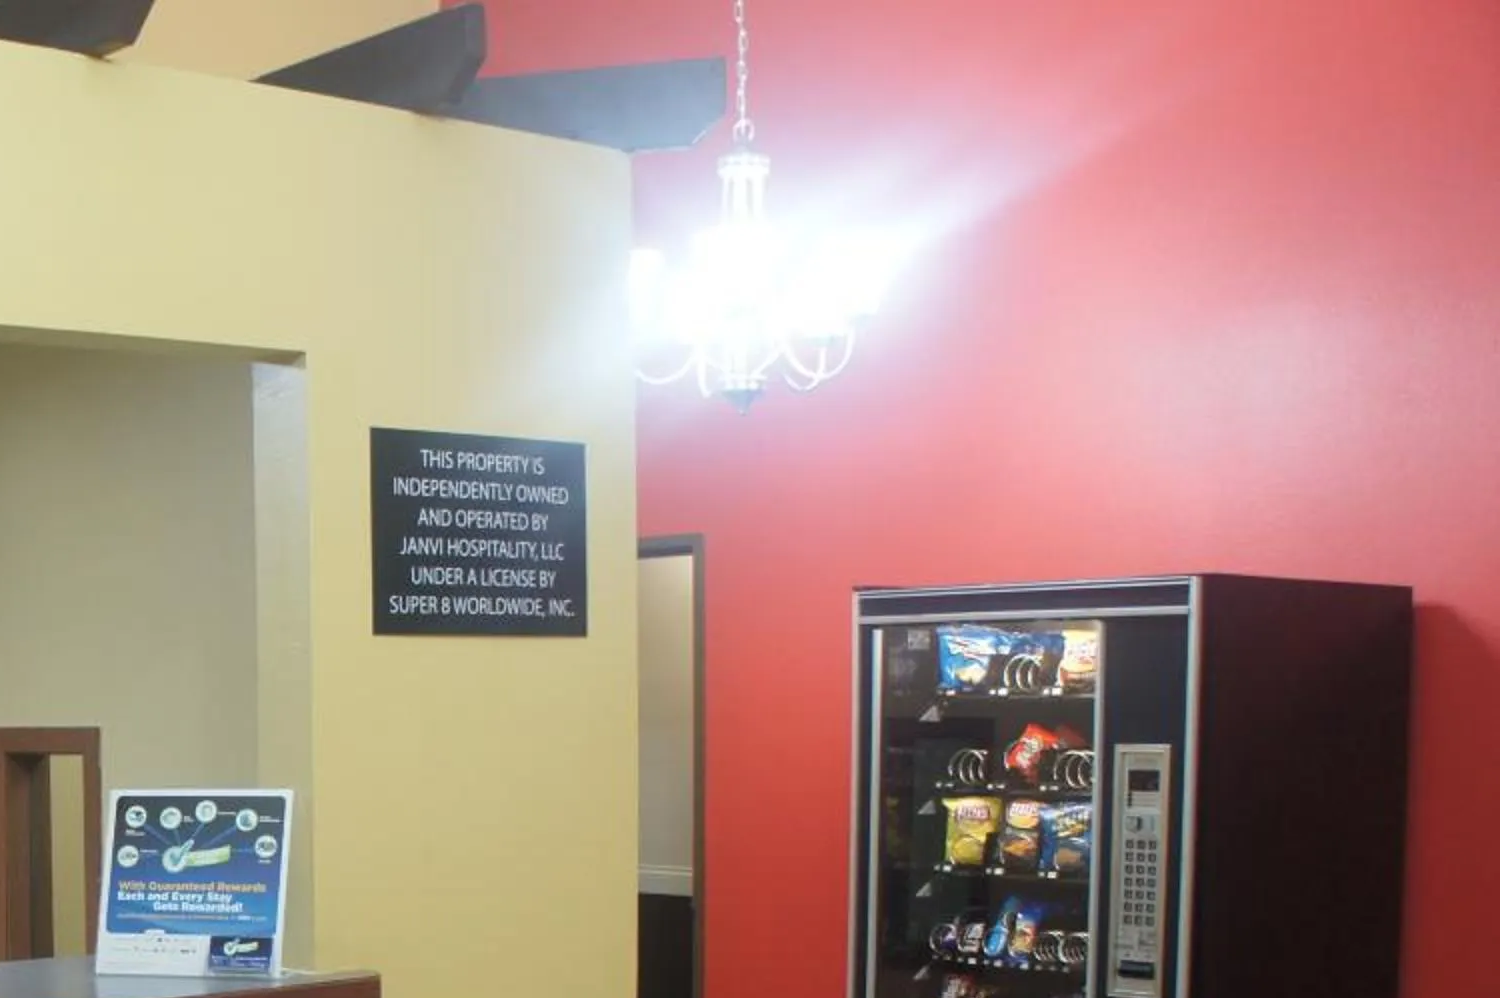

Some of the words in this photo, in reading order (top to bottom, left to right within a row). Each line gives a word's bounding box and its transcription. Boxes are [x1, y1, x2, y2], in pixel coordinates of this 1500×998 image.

[420, 449, 453, 469] THIS
[457, 451, 528, 474] PROPERTY
[532, 456, 545, 475] IS
[393, 476, 513, 501] INDEPENDENTLY
[516, 484, 569, 505] OWNED
[417, 508, 452, 527] AND
[455, 509, 529, 530] OPERATED
[531, 512, 549, 531] BY
[400, 536, 443, 556] JANVI
[447, 538, 538, 561] HOSPITALITY,
[541, 543, 565, 561] LLC
[411, 566, 463, 586] UNDER
[467, 568, 477, 586] A
[481, 569, 537, 588] LICENSE
[539, 570, 557, 588] BY
[389, 595, 438, 615] SUPER
[441, 596, 450, 615] 8
[453, 597, 546, 619] WORLDWIDE,
[549, 599, 575, 617] INC.
[117, 880, 146, 891] With
[149, 881, 215, 892] Guaranteed
[117, 891, 145, 901] Each
[148, 892, 169, 901] and
[171, 892, 203, 903] Every
[206, 892, 233, 903] Stay
[153, 902, 180, 912] Gets
[181, 902, 244, 913] Rewarded!
